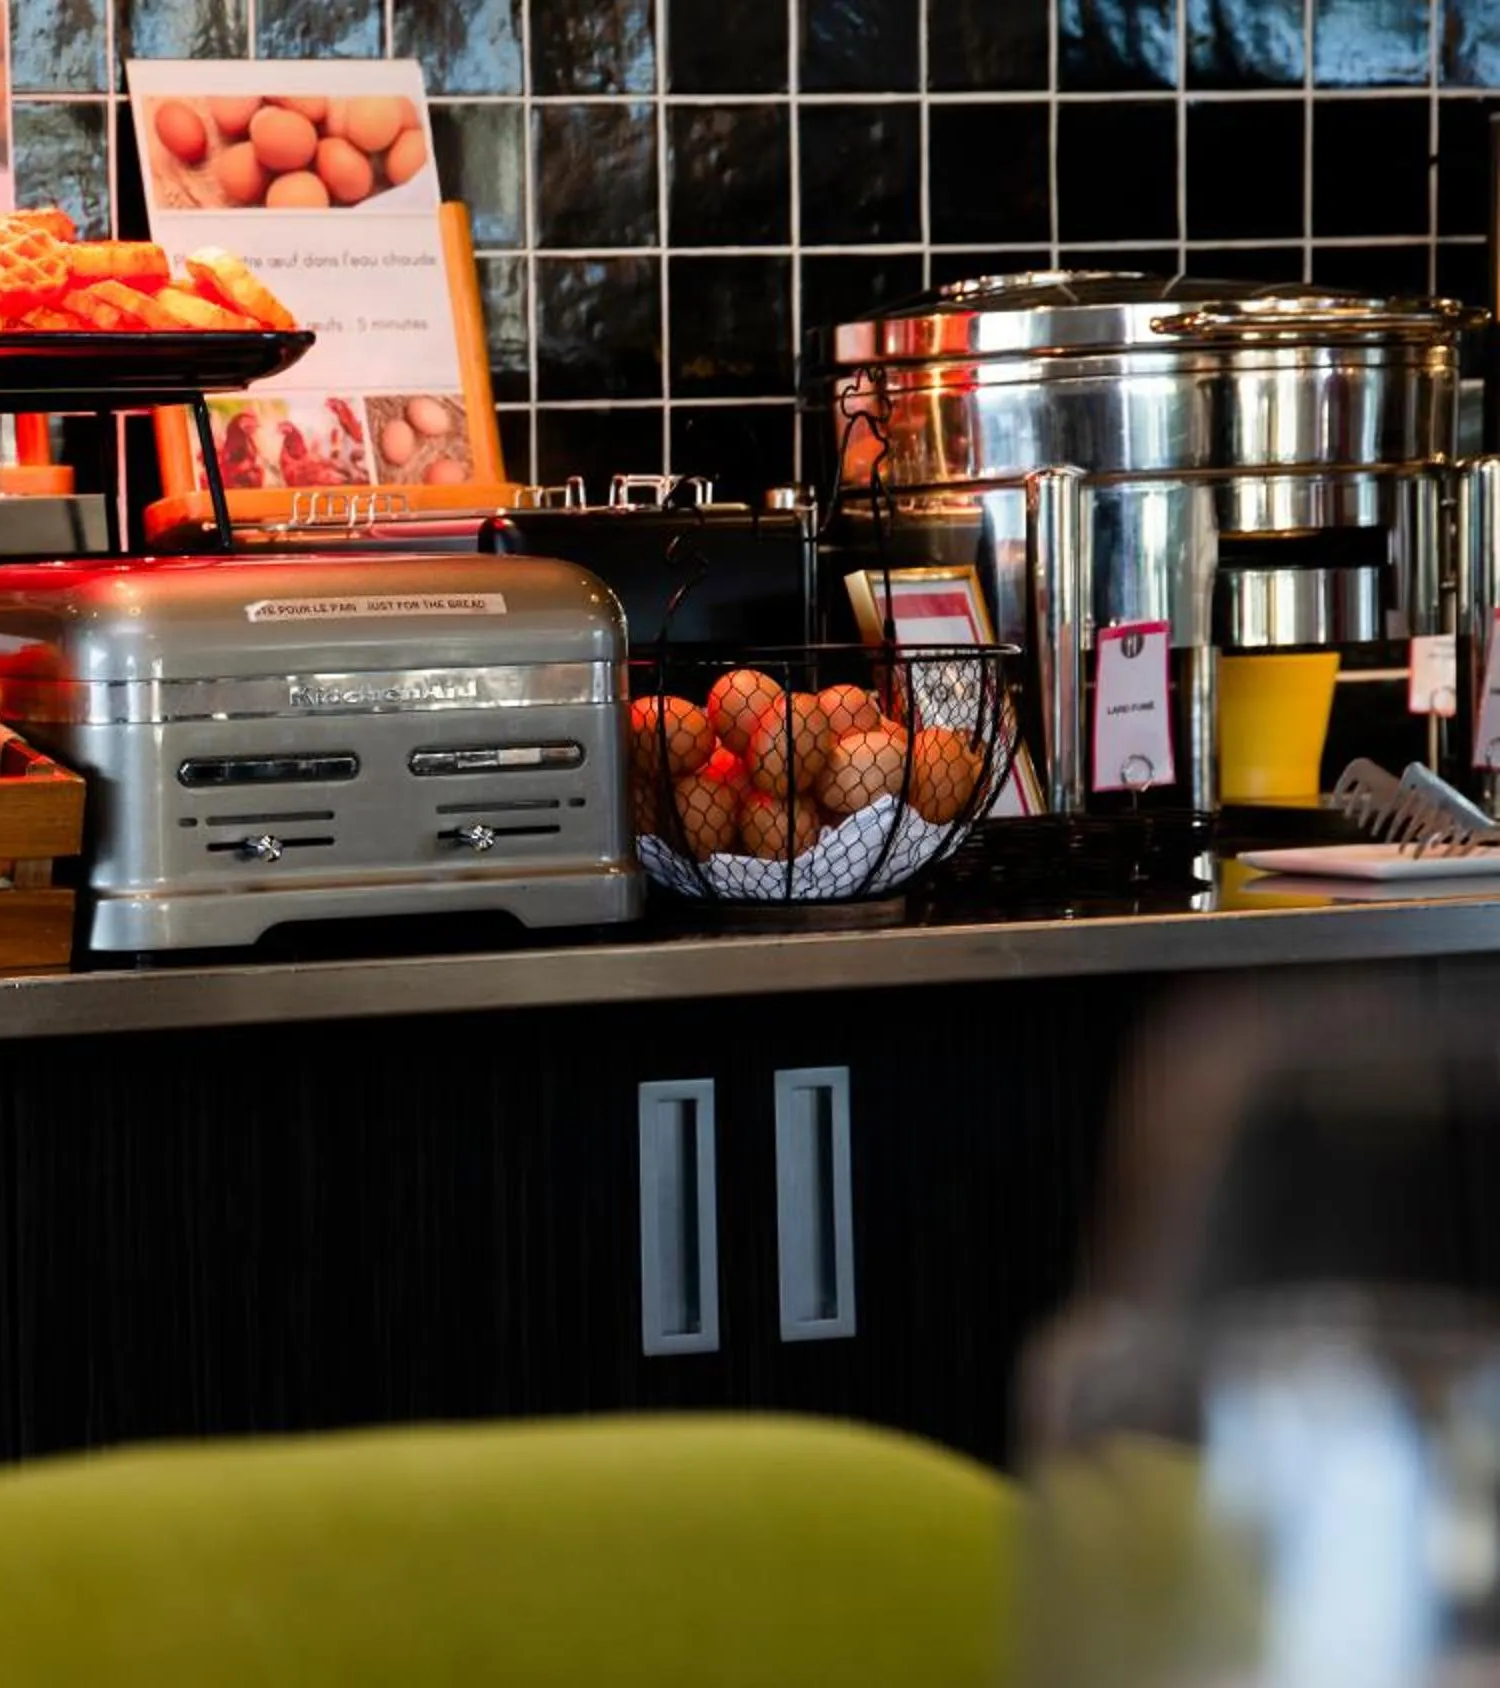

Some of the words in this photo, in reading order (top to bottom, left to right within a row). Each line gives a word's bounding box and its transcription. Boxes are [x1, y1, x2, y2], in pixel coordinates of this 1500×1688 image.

[302, 252, 340, 268] dans
[380, 252, 437, 267] chaude
[371, 318, 428, 332] minutes
[330, 602, 357, 613] PAIN
[367, 599, 394, 611] JUST
[396, 599, 420, 610] FOR
[422, 598, 445, 609] THE
[447, 599, 485, 609] BREAD
[290, 681, 477, 707] KitchenAid
[1106, 704, 1130, 715] LARD
